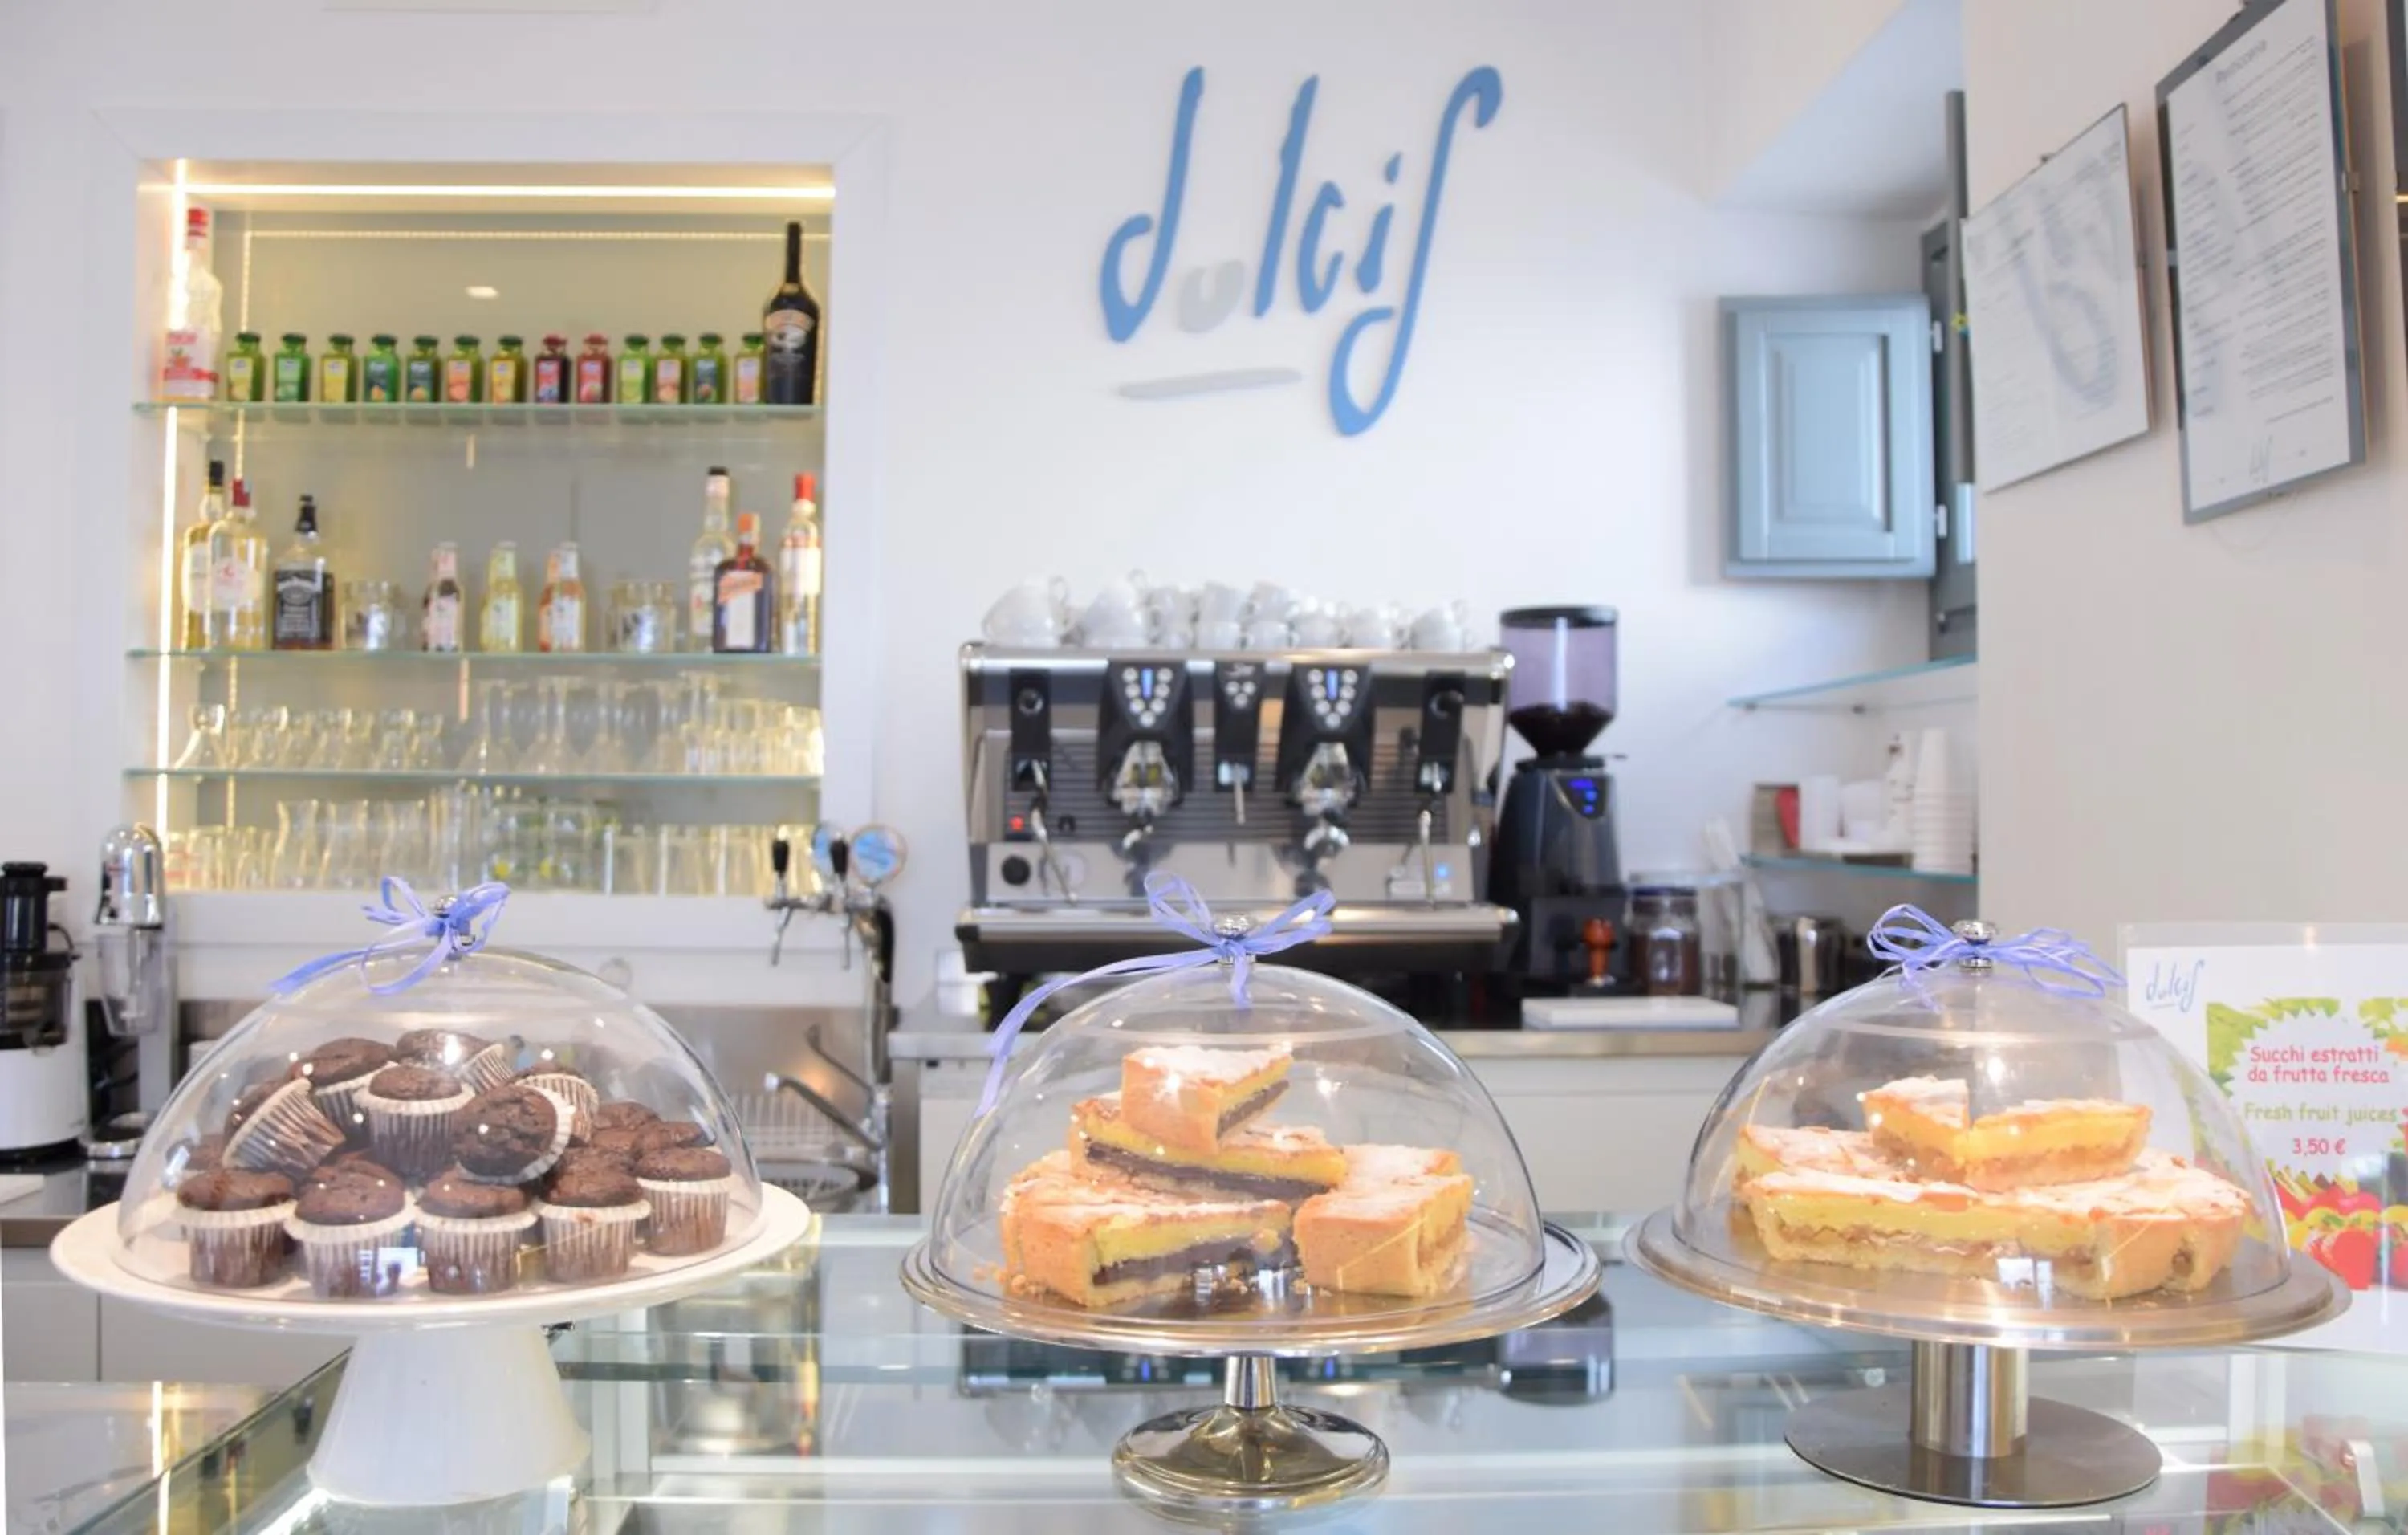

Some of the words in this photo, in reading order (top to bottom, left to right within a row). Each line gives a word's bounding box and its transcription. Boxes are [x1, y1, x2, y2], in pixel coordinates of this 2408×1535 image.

[2249, 1046, 2304, 1062] Succhi
[2310, 1046, 2379, 1062] estratti
[2247, 1067, 2268, 1083] da
[2273, 1067, 2328, 1083] frutta
[2333, 1067, 2390, 1083] fresca
[2244, 1102, 2292, 1121] Fresh
[2299, 1102, 2339, 1121] fruit
[2345, 1104, 2398, 1126] juices
[2292, 1138, 2329, 1156] 3,50
[2334, 1138, 2346, 1154] €
